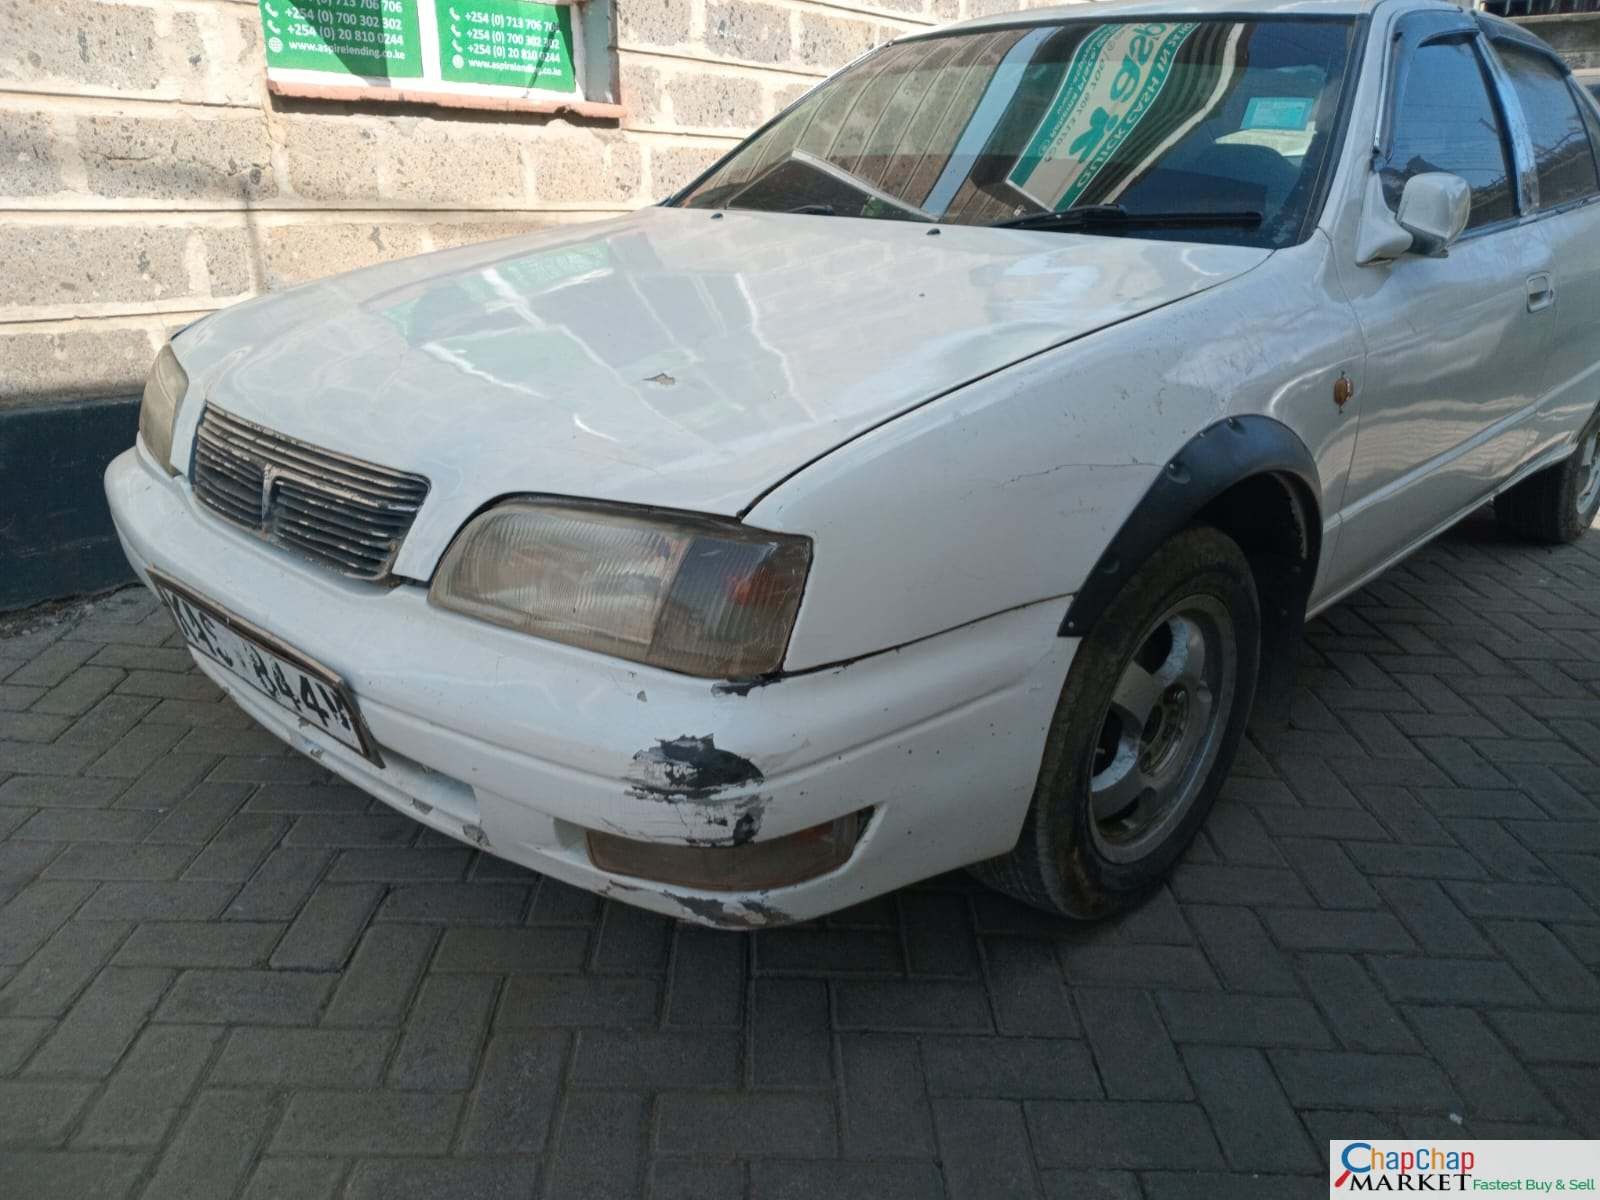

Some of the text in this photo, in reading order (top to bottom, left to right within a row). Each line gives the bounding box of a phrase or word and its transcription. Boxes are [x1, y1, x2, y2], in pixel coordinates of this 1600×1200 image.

[360, 0, 380, 10] 706
[382, 1, 403, 13] 706
[285, 7, 402, 30] +254 (0) 700 302 302
[465, 11, 489, 24] +254
[491, 12, 505, 28] (0)
[287, 23, 404, 45] +254 (0) 20 810 0244
[466, 28, 490, 41] +254
[492, 31, 505, 45] (0)
[506, 33, 524, 45] 700
[288, 41, 406, 59] www.aspirelending.co.ke
[467, 43, 491, 55] +254
[493, 45, 506, 59] (0)
